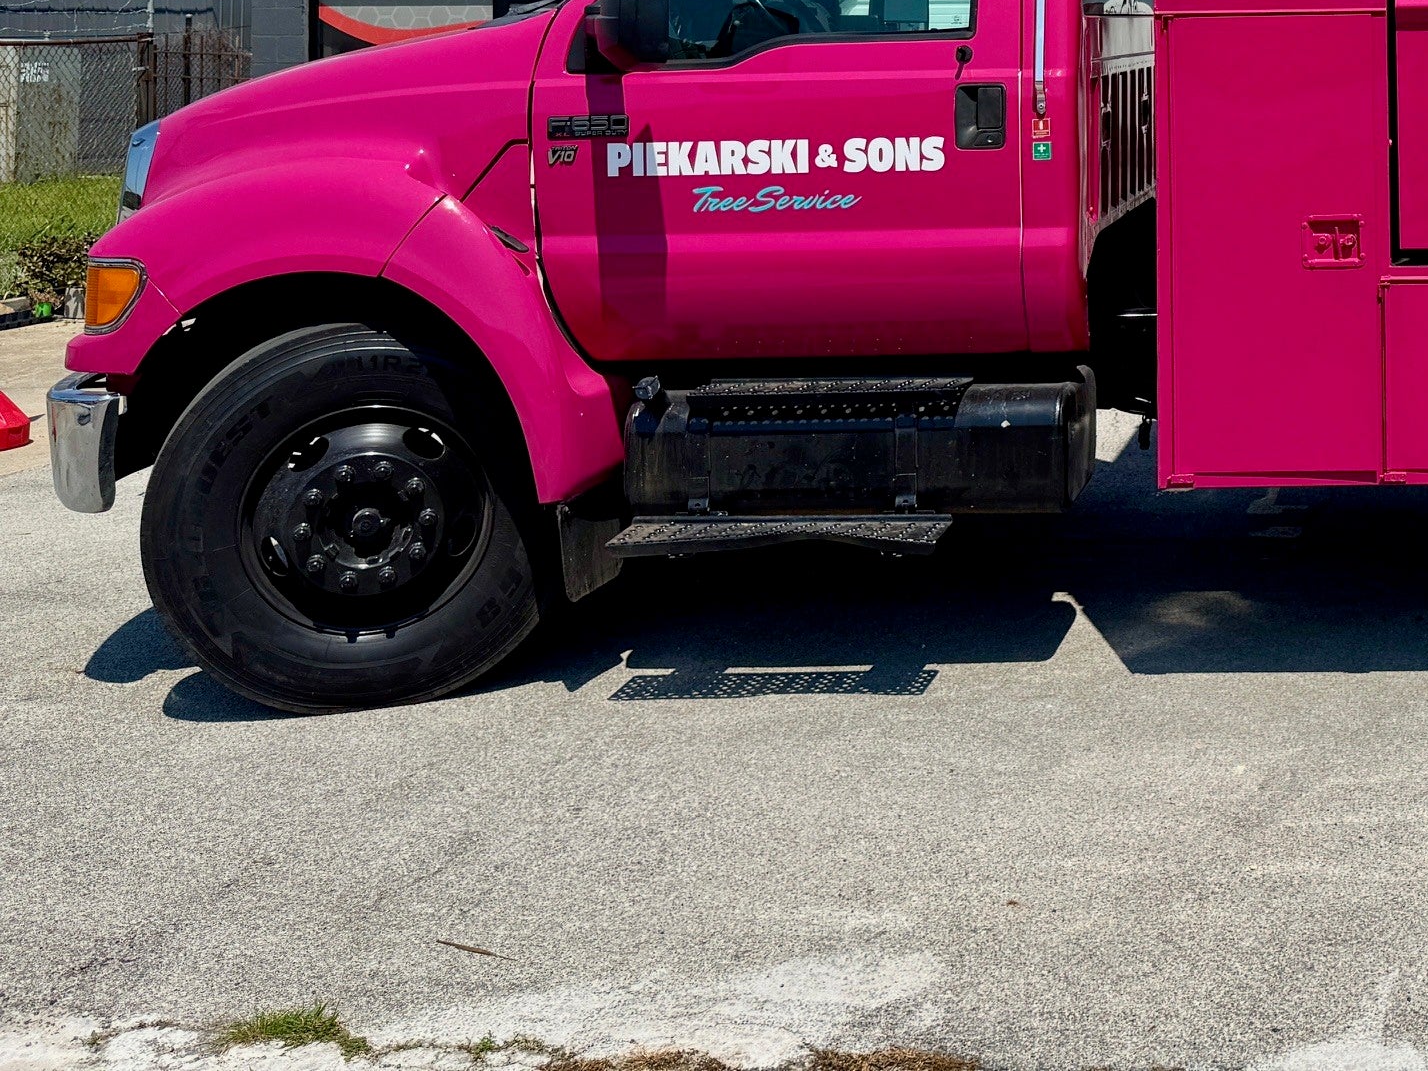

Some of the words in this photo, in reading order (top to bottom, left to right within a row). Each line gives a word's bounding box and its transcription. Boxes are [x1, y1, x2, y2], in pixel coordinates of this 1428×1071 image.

[547, 150, 575, 165] V10
[606, 139, 810, 177] PIEKARSKI
[814, 143, 838, 168] &
[843, 136, 945, 173] SONS
[692, 186, 754, 212] Tree
[748, 185, 862, 212] Service
